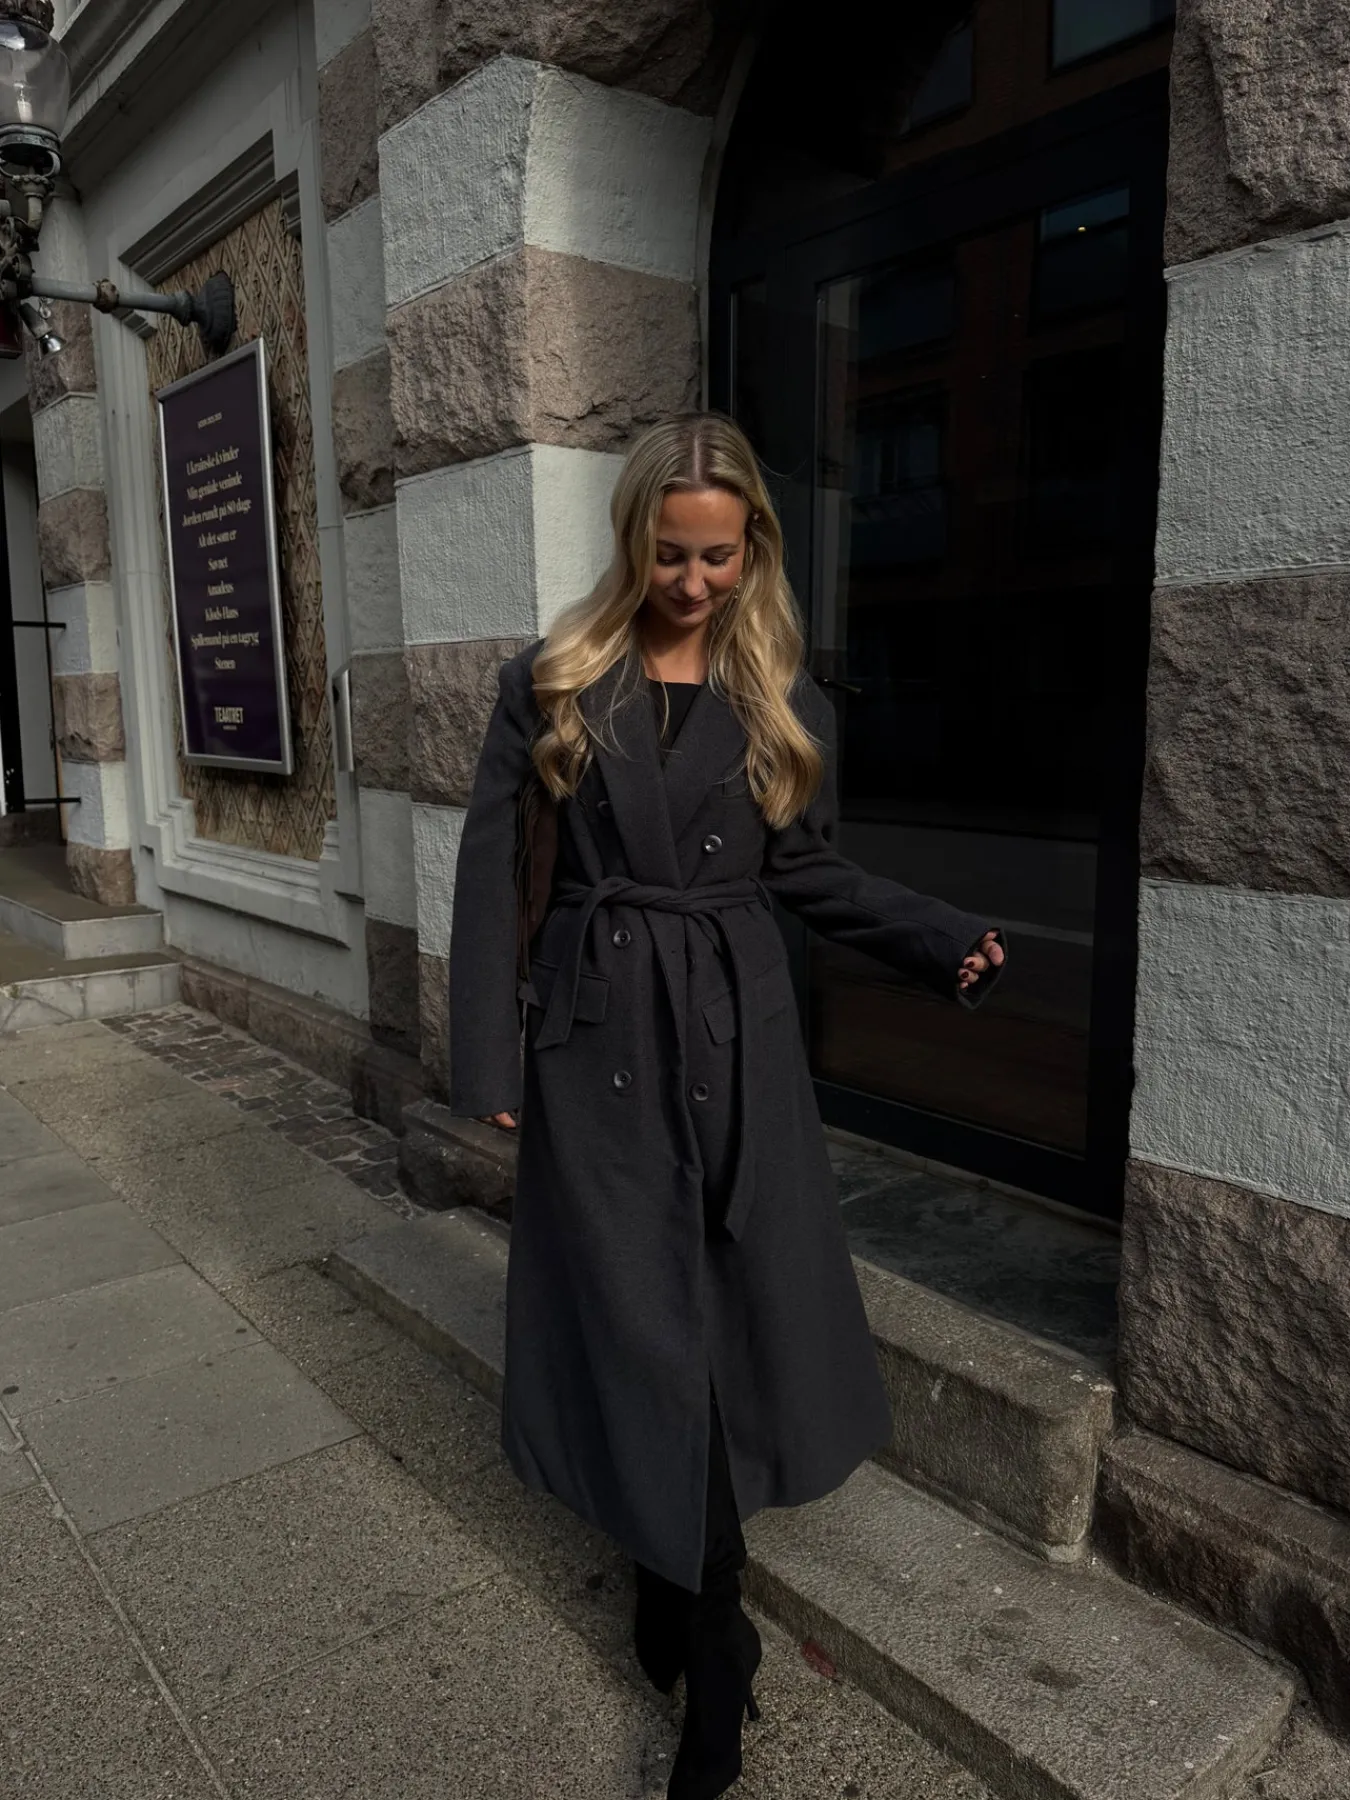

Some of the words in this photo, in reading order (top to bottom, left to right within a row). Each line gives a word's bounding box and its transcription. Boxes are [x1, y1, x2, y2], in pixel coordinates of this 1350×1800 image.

[219, 470, 242, 490] veninde
[182, 511, 202, 527] Jorden
[202, 504, 219, 522] rundt
[218, 503, 227, 521] på
[226, 501, 236, 515] 80
[236, 497, 252, 514] dage
[206, 531, 216, 546] det
[229, 529, 237, 541] er
[207, 579, 234, 596] Amadeus
[190, 631, 222, 650] Spillemand
[229, 633, 238, 644] en
[238, 631, 260, 647] tagryg
